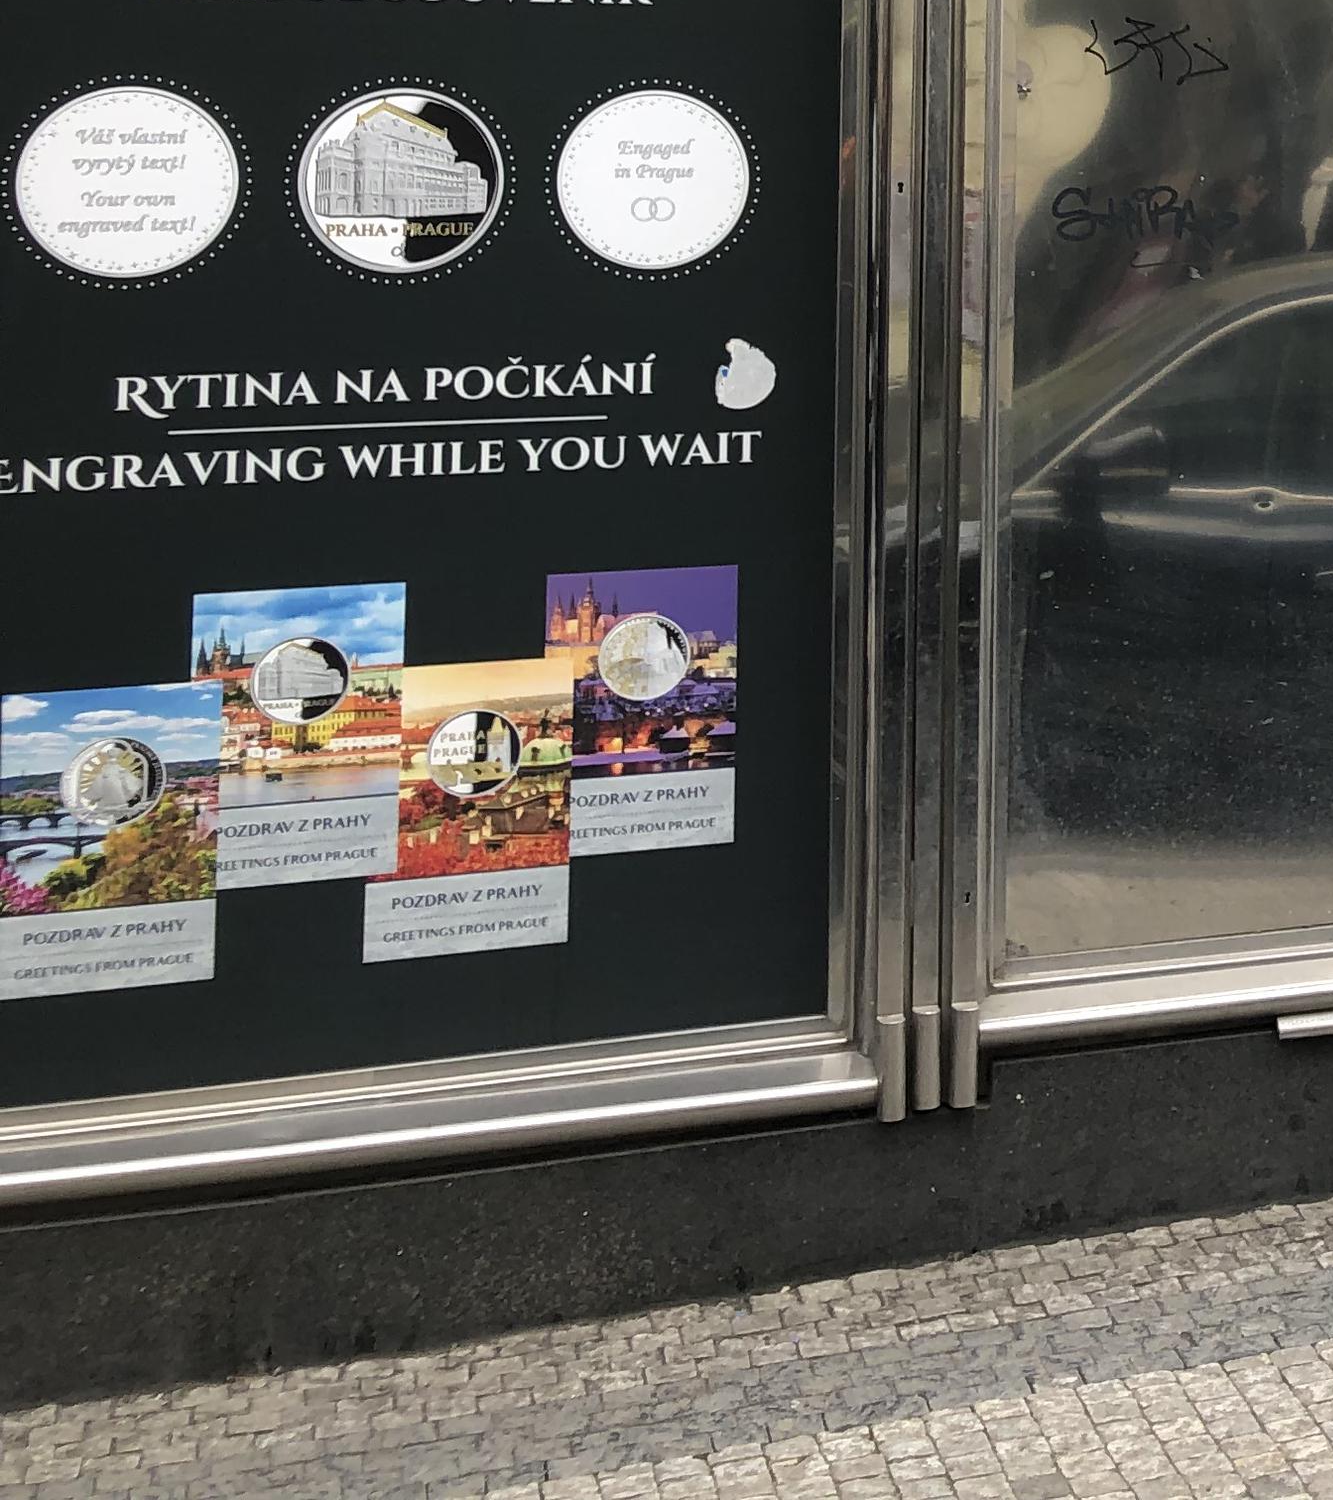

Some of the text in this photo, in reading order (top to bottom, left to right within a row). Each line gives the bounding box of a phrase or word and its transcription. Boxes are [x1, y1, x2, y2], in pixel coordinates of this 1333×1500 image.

[75, 127, 188, 145] Váš vlastní
[617, 138, 695, 160] Engaged
[72, 155, 186, 176] vyrytý text!
[614, 163, 695, 183] in Prague
[81, 190, 176, 208] Your own
[57, 215, 196, 238] engraved text!
[325, 221, 474, 237] PRAHA PRAGUE
[113, 352, 657, 419] RYTINA NA POČKÁNÍ
[0, 430, 763, 495] ENGRAVING WHILE YOU WAIT
[643, 790, 654, 803] Z
[657, 786, 710, 801] PRAHY
[299, 818, 310, 833] Z
[313, 813, 372, 831] PRAHY
[569, 817, 717, 840] REETINGS FROM PRAGUE
[215, 847, 378, 873] REETINGS FROM PRAGUE
[391, 884, 544, 911] POZDRAV Z PRAHY
[22, 918, 187, 946] POZDRAV Z PRAHY
[383, 916, 550, 943] GREETINGS FROM PRAGUE
